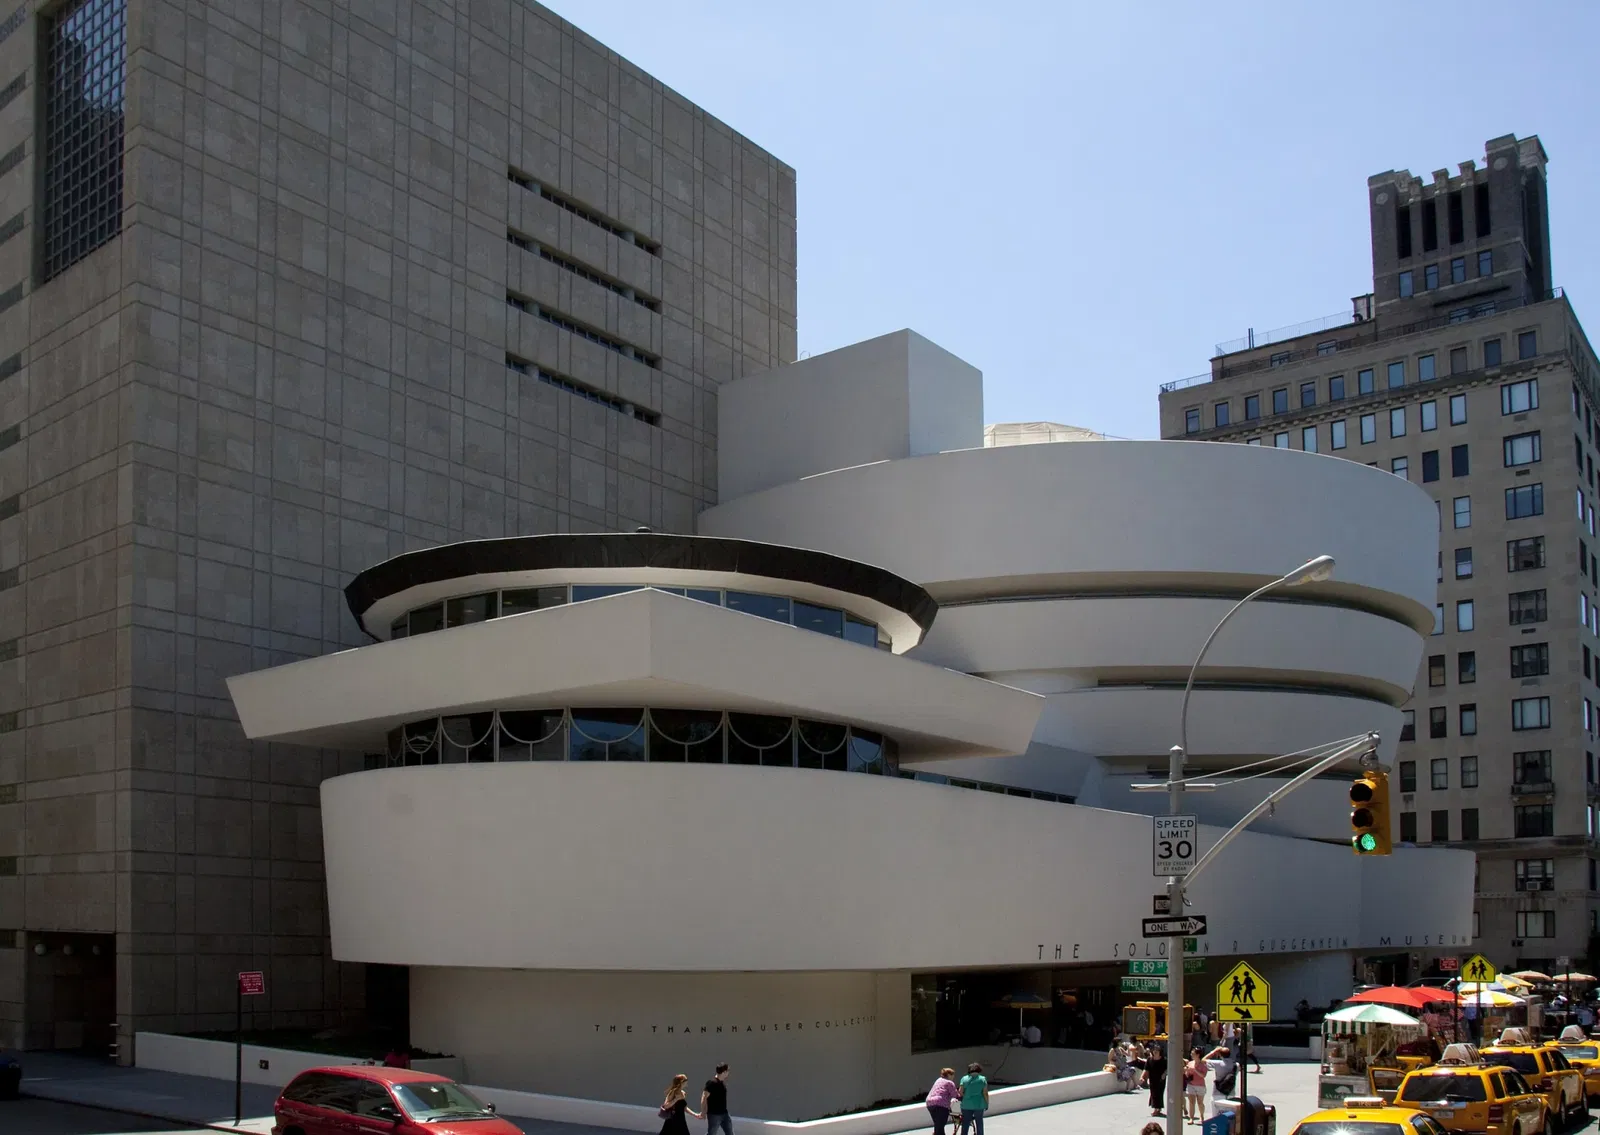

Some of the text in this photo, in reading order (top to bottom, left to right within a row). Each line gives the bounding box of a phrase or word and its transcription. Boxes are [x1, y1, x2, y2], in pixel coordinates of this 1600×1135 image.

[1156, 819, 1195, 828] SPEED
[1160, 829, 1190, 839] LIMIT
[1158, 840, 1192, 859] 30
[1150, 920, 1199, 932] ONE WAY
[1037, 943, 1080, 960] THE
[1113, 940, 1210, 958] SOLON
[1259, 936, 1348, 952] GUGGENHEIM
[1379, 934, 1468, 946] MUSEUM
[1133, 961, 1139, 973] E
[1142, 962, 1155, 973] 89
[1122, 979, 1139, 987] FRED
[594, 1024, 633, 1033] THE
[651, 1021, 804, 1034] THANNHAUSER
